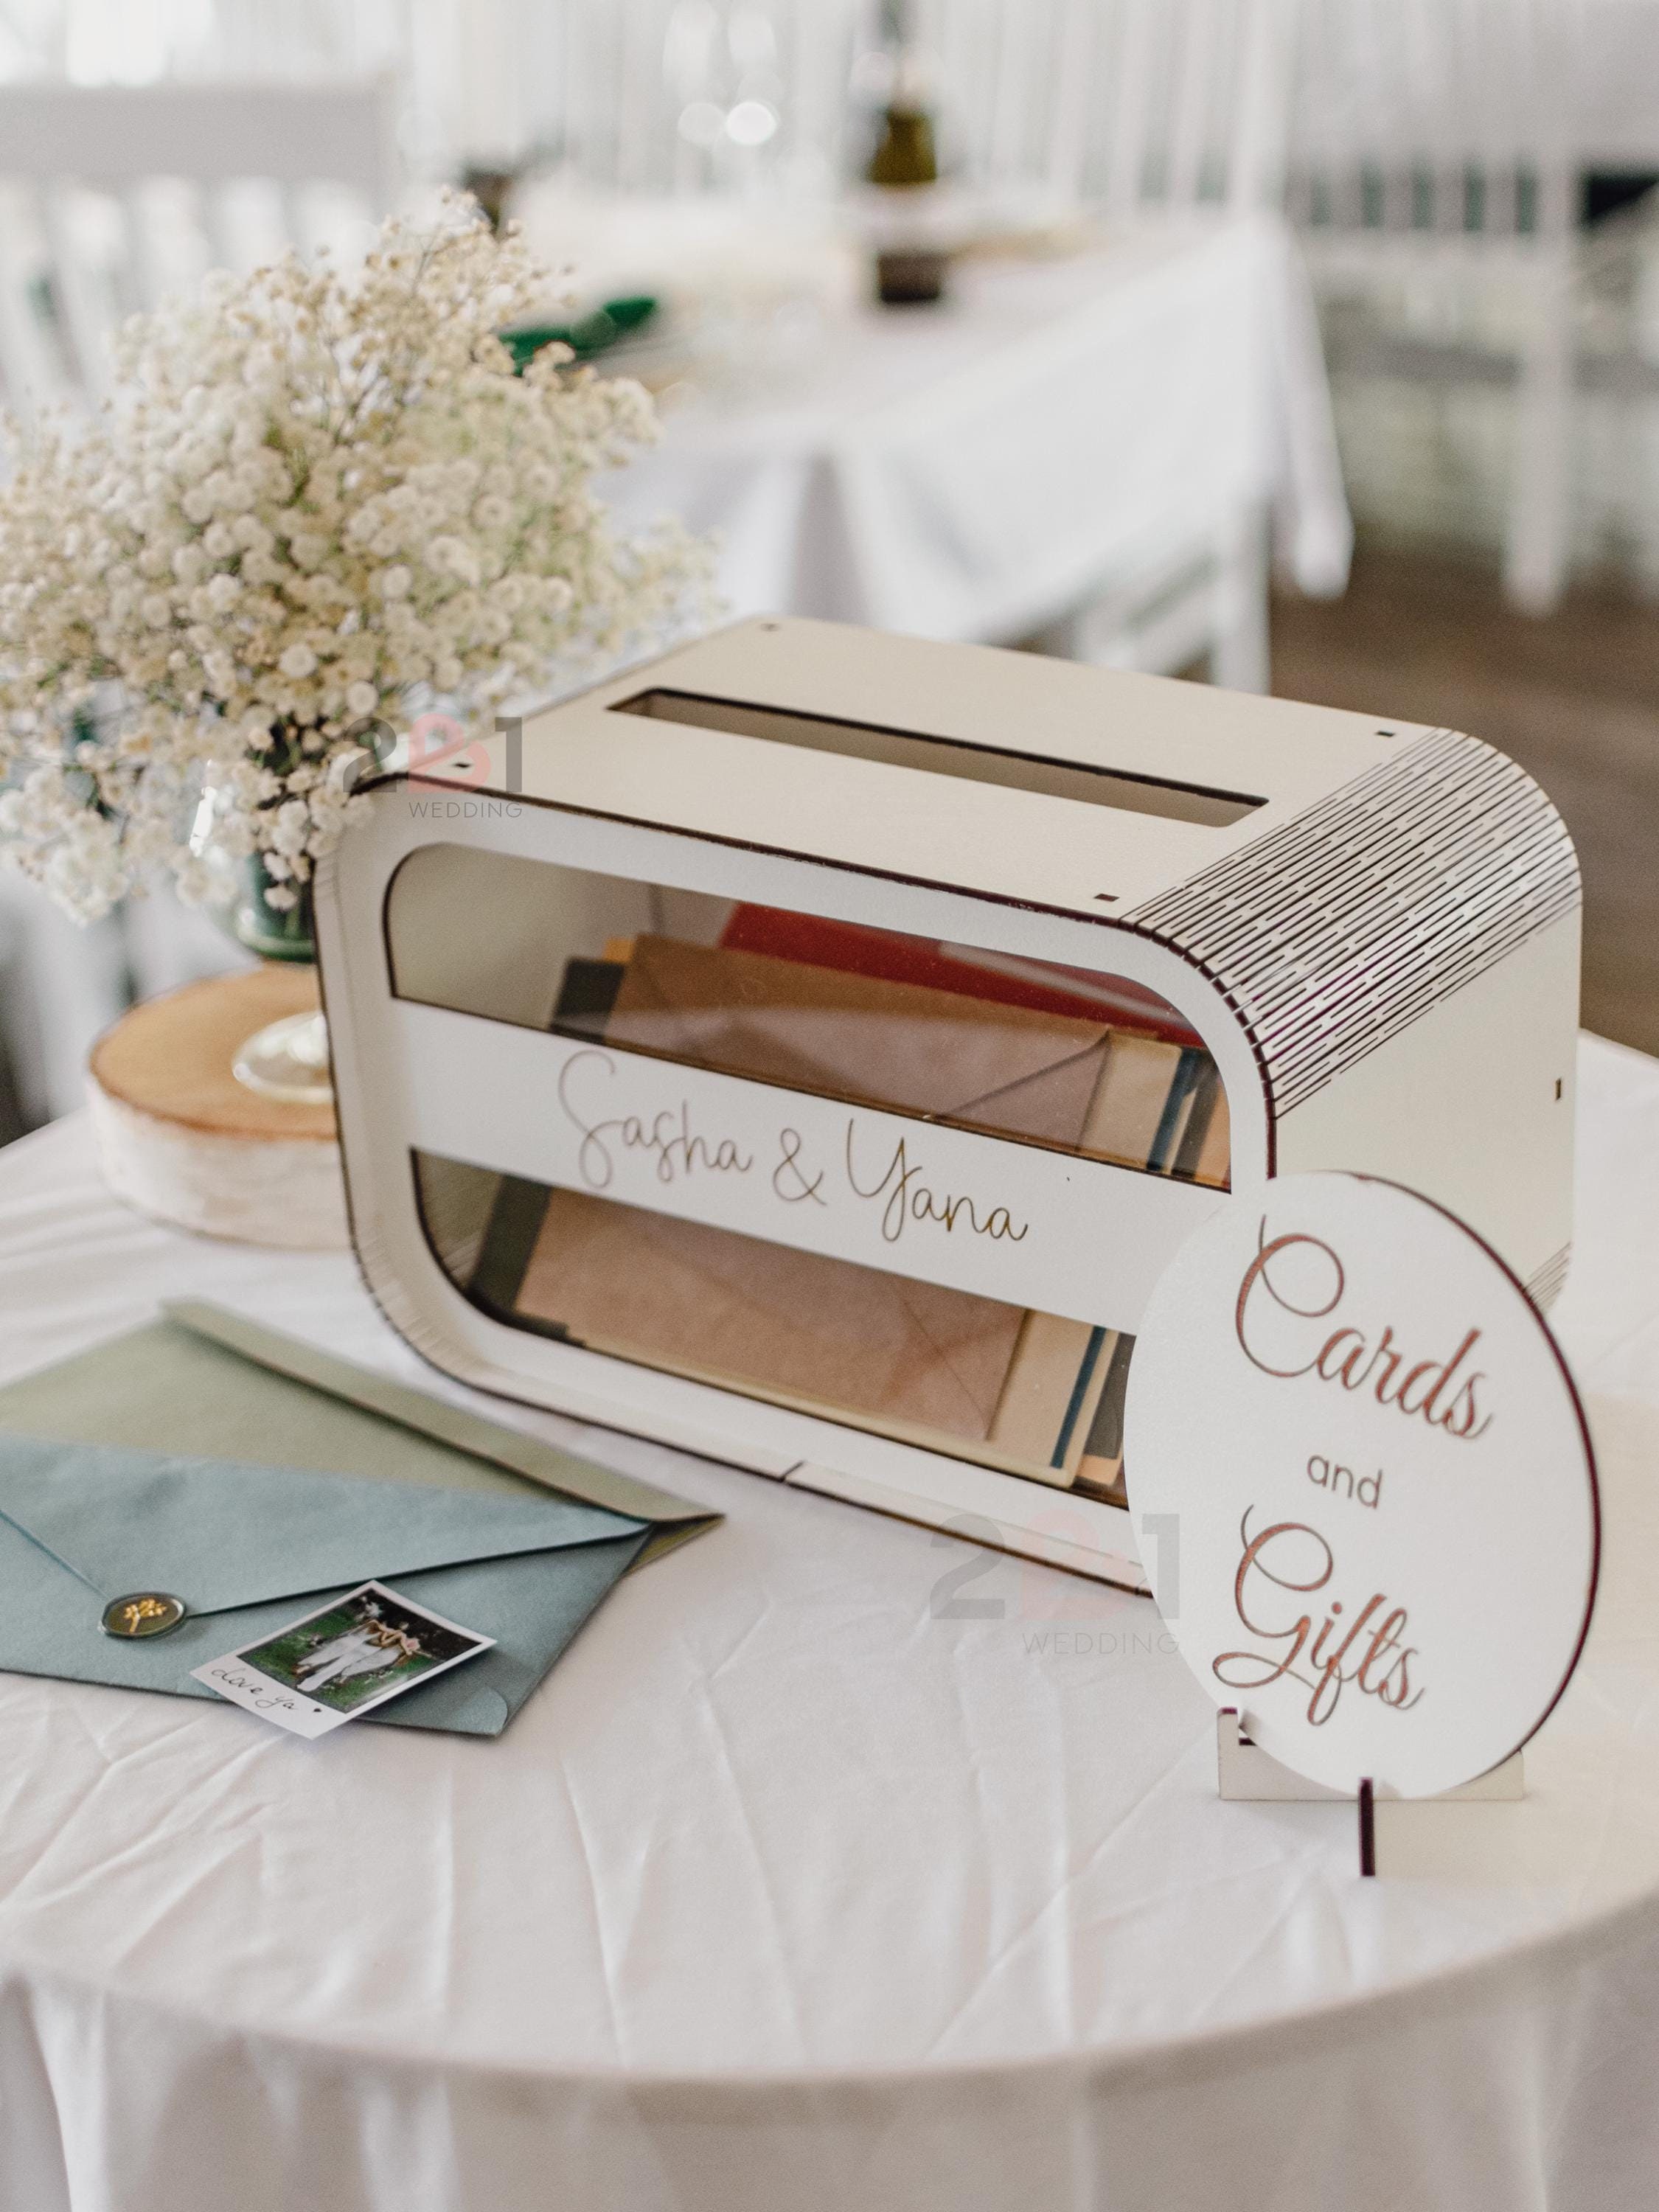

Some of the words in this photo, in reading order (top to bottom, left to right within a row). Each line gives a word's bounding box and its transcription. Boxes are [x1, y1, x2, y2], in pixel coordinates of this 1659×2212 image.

[558, 1049, 754, 1188] Sasha
[772, 1127, 827, 1206] &
[846, 1118, 1029, 1242] Yana
[1235, 1214, 1493, 1439] Cards
[1307, 1454, 1382, 1509] and
[1211, 1504, 1426, 1726] Gifts
